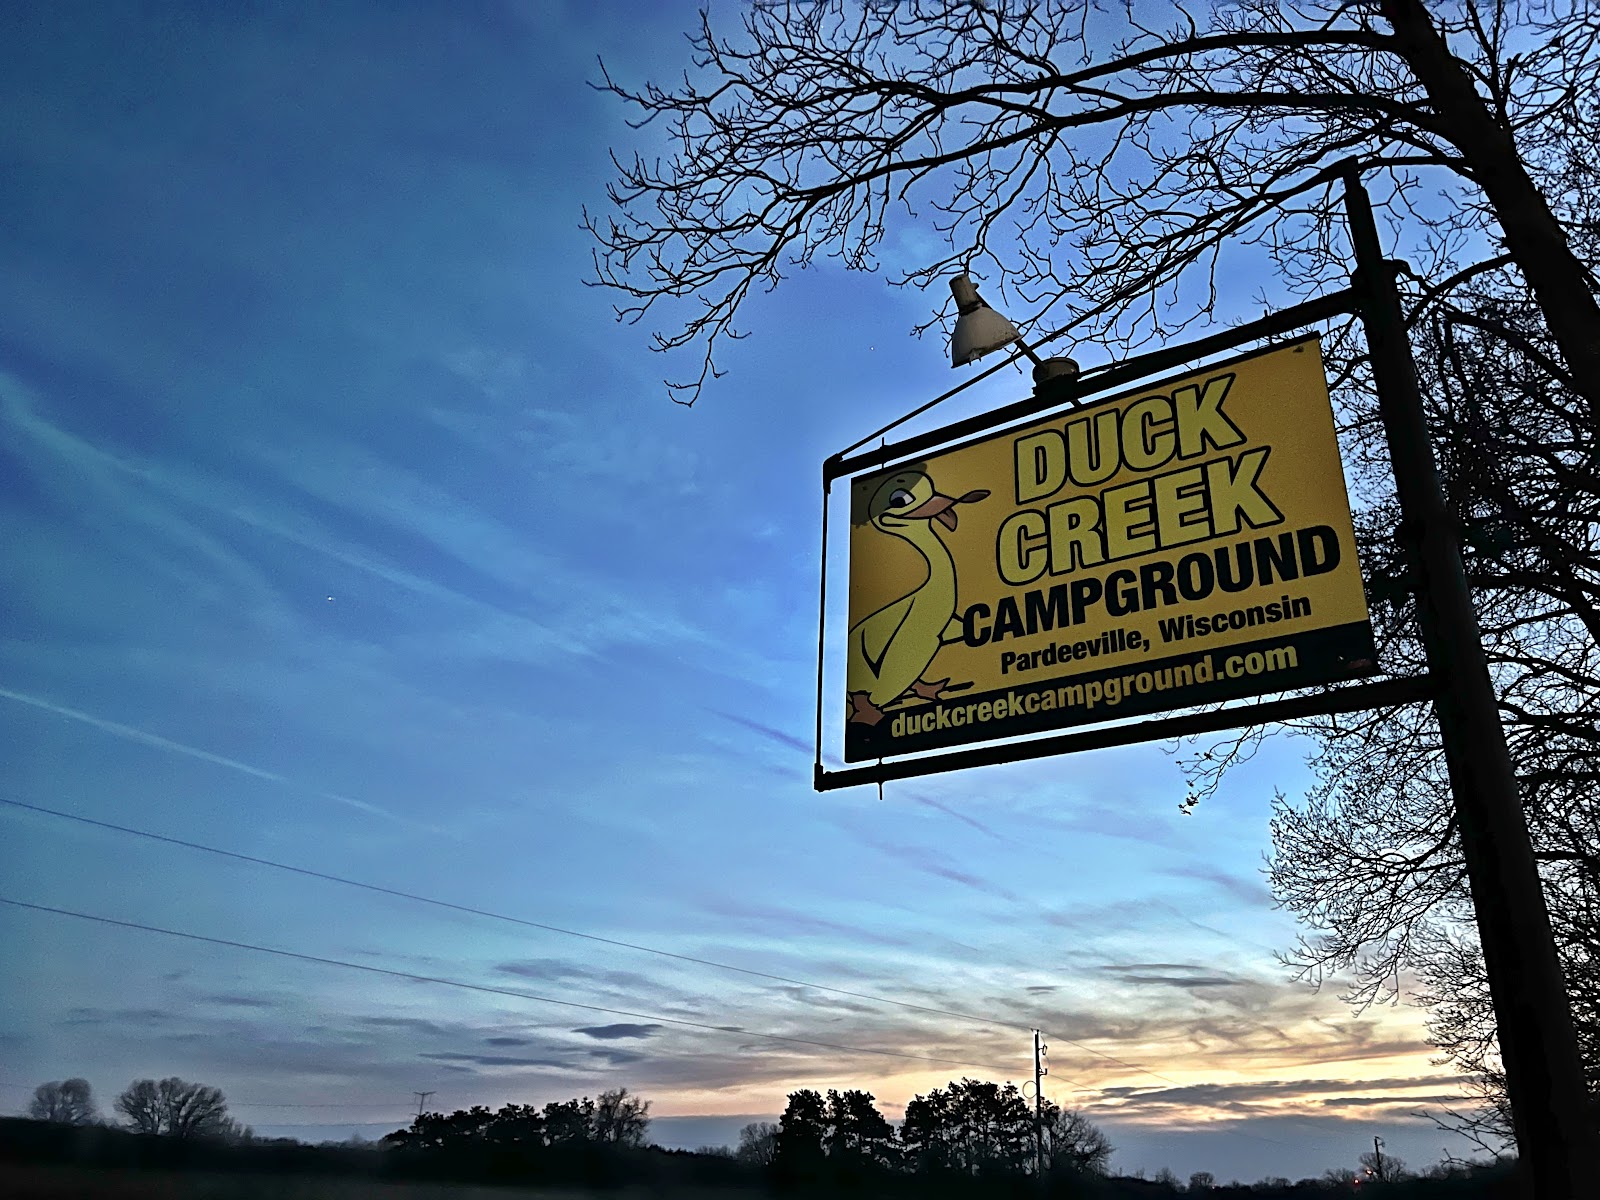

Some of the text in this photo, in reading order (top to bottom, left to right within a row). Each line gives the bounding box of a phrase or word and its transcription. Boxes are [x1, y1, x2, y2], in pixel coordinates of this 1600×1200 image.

[1014, 372, 1247, 505] DUCK
[996, 446, 1285, 586] CREEK
[961, 524, 1341, 647] CAMPGROUND
[1001, 596, 1312, 675] Pardeeville, Wisconsin
[891, 645, 1298, 738] duckcreekcampground.com
